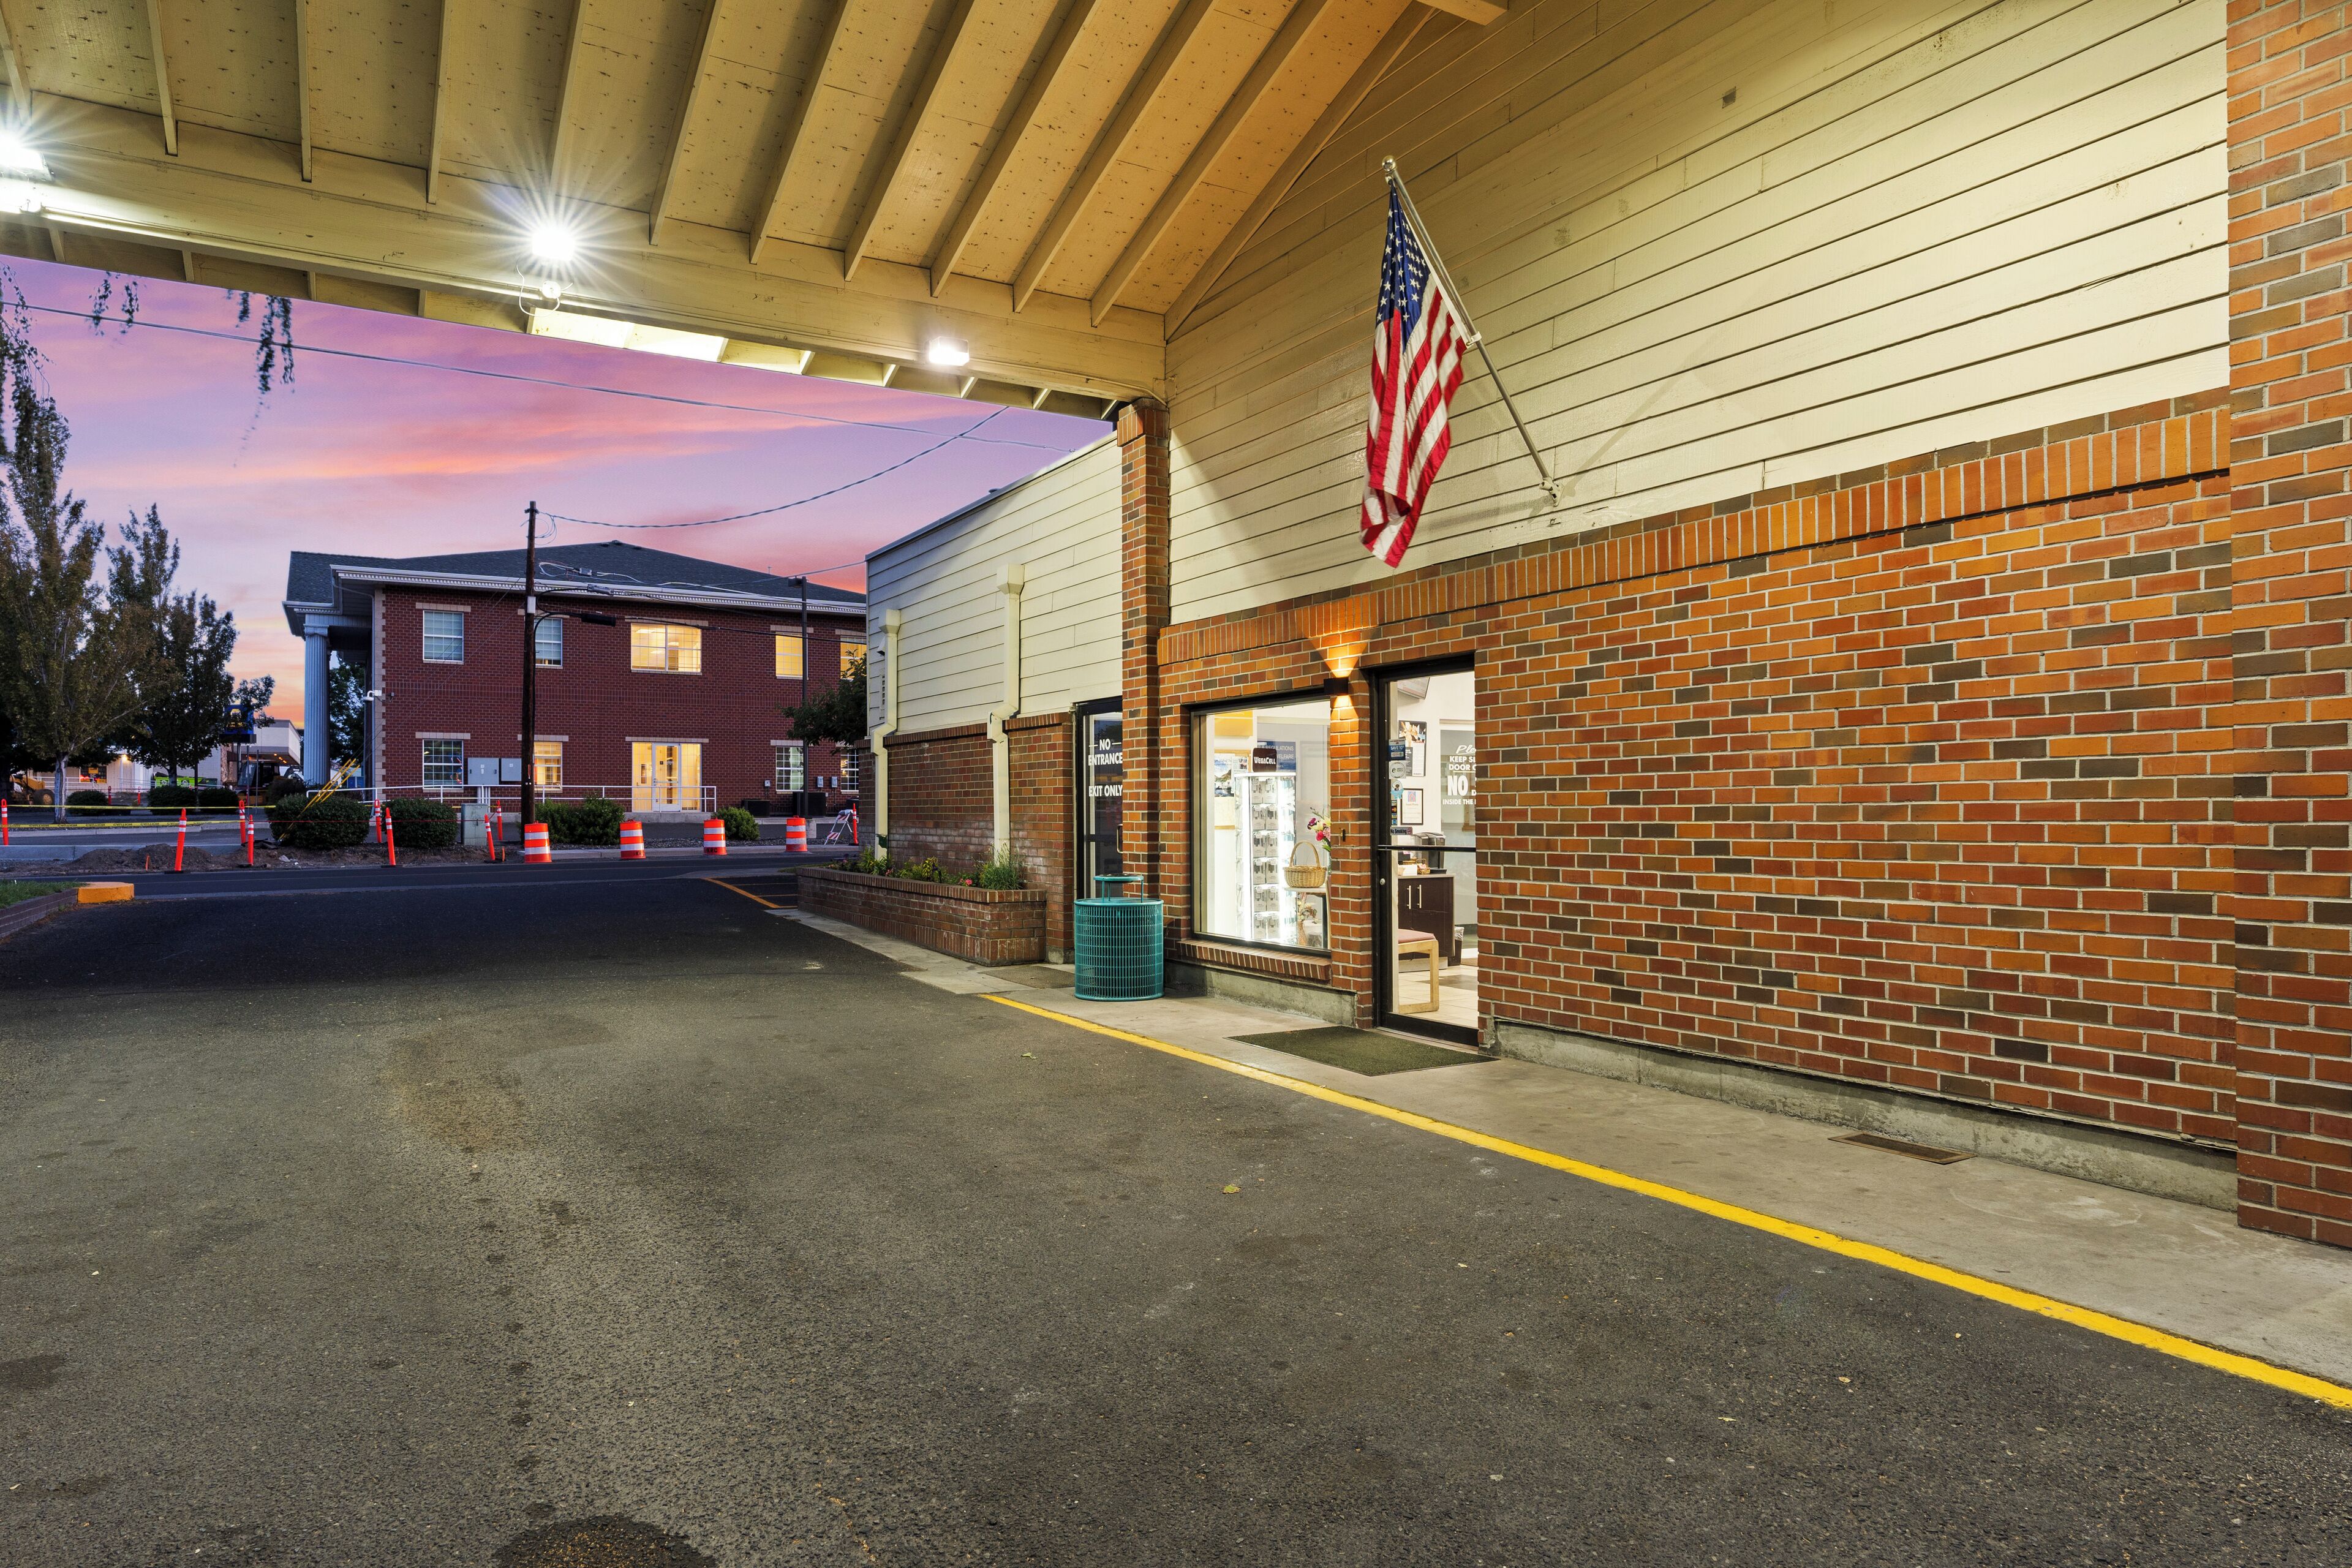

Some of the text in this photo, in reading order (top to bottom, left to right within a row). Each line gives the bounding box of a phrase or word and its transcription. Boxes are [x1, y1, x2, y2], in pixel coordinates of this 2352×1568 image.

[1099, 738, 1111, 751] NO
[1088, 752, 1123, 766] ENTRANCE
[1088, 785, 1123, 797] EXIT ONLY
[1447, 775, 1469, 796] NO
